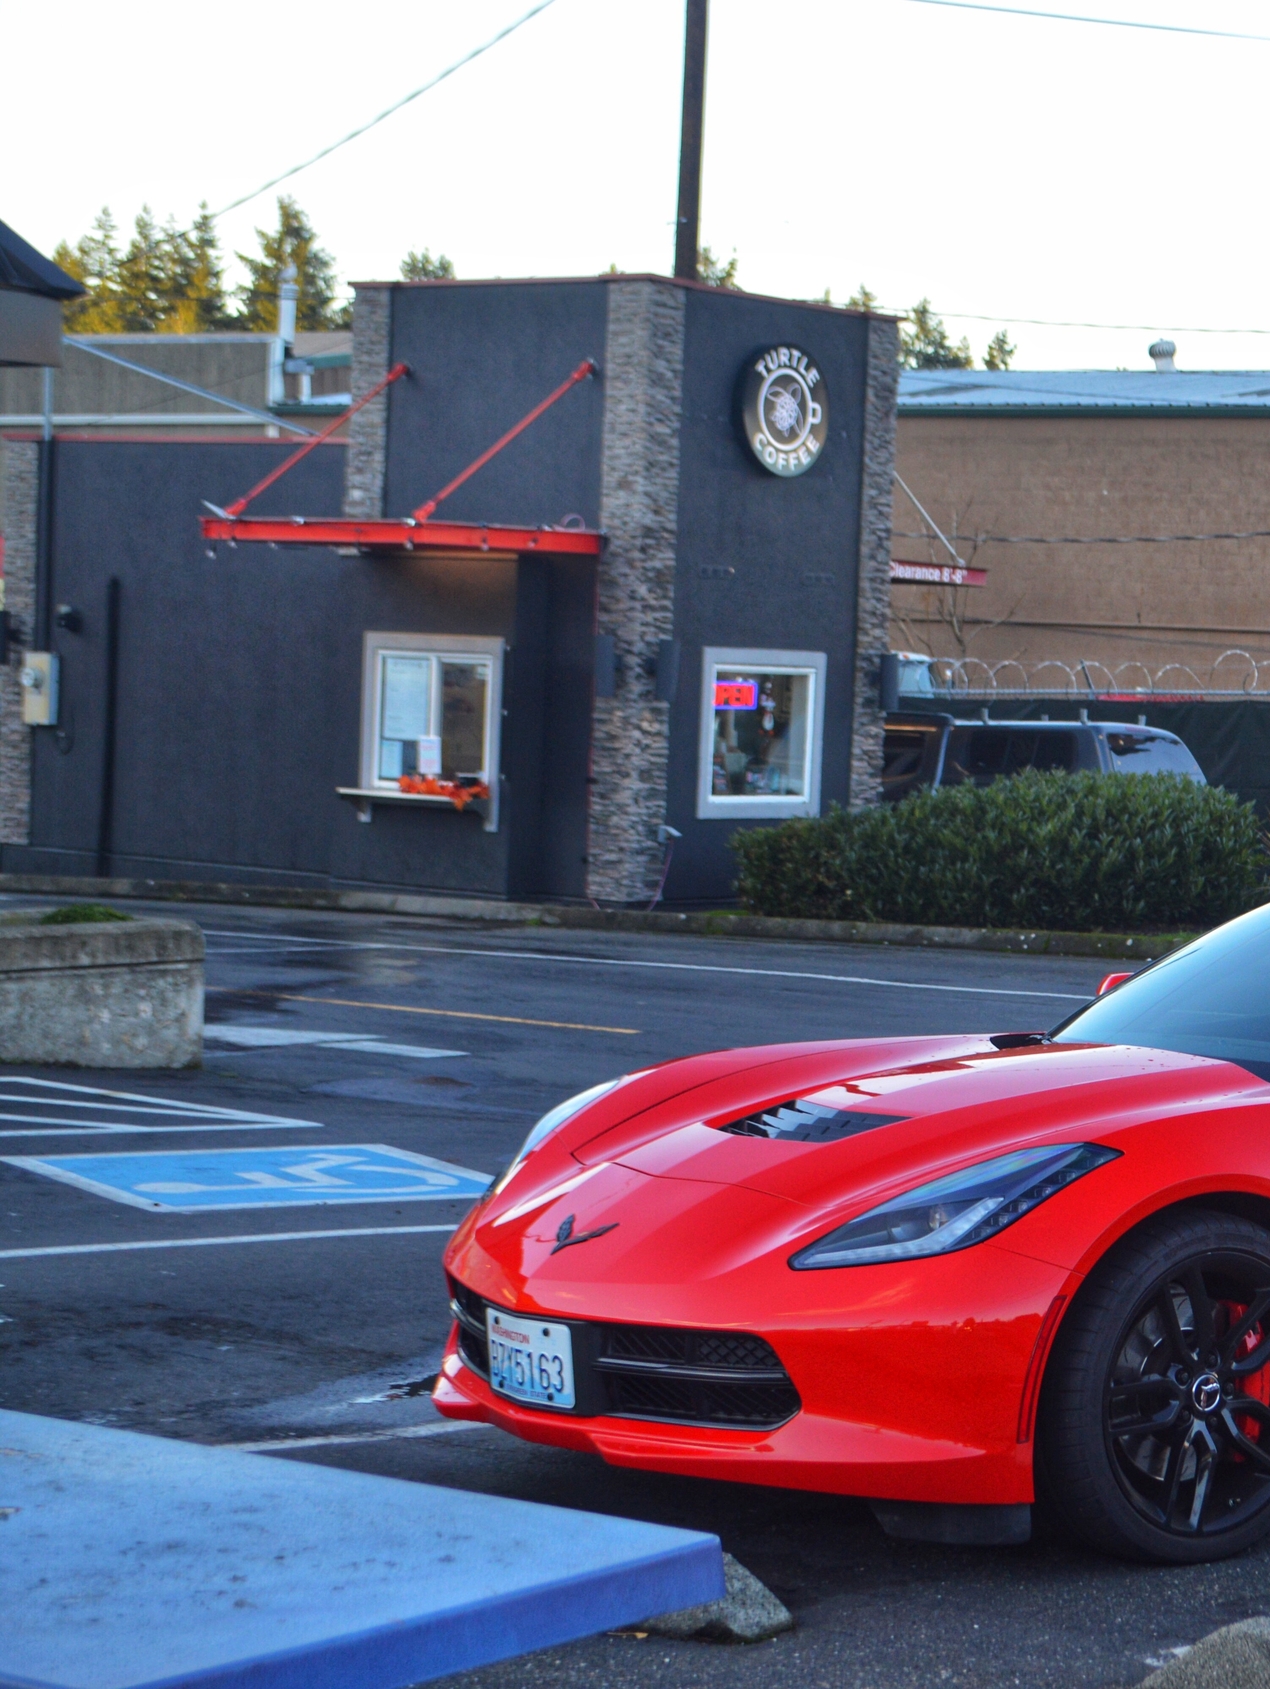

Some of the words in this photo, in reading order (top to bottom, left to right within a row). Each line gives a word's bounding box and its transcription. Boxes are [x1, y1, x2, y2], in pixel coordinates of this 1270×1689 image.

[754, 347, 820, 388] TURTLE
[754, 432, 820, 470] COFFEE
[889, 561, 941, 581] Clearance
[714, 683, 755, 707] PEN
